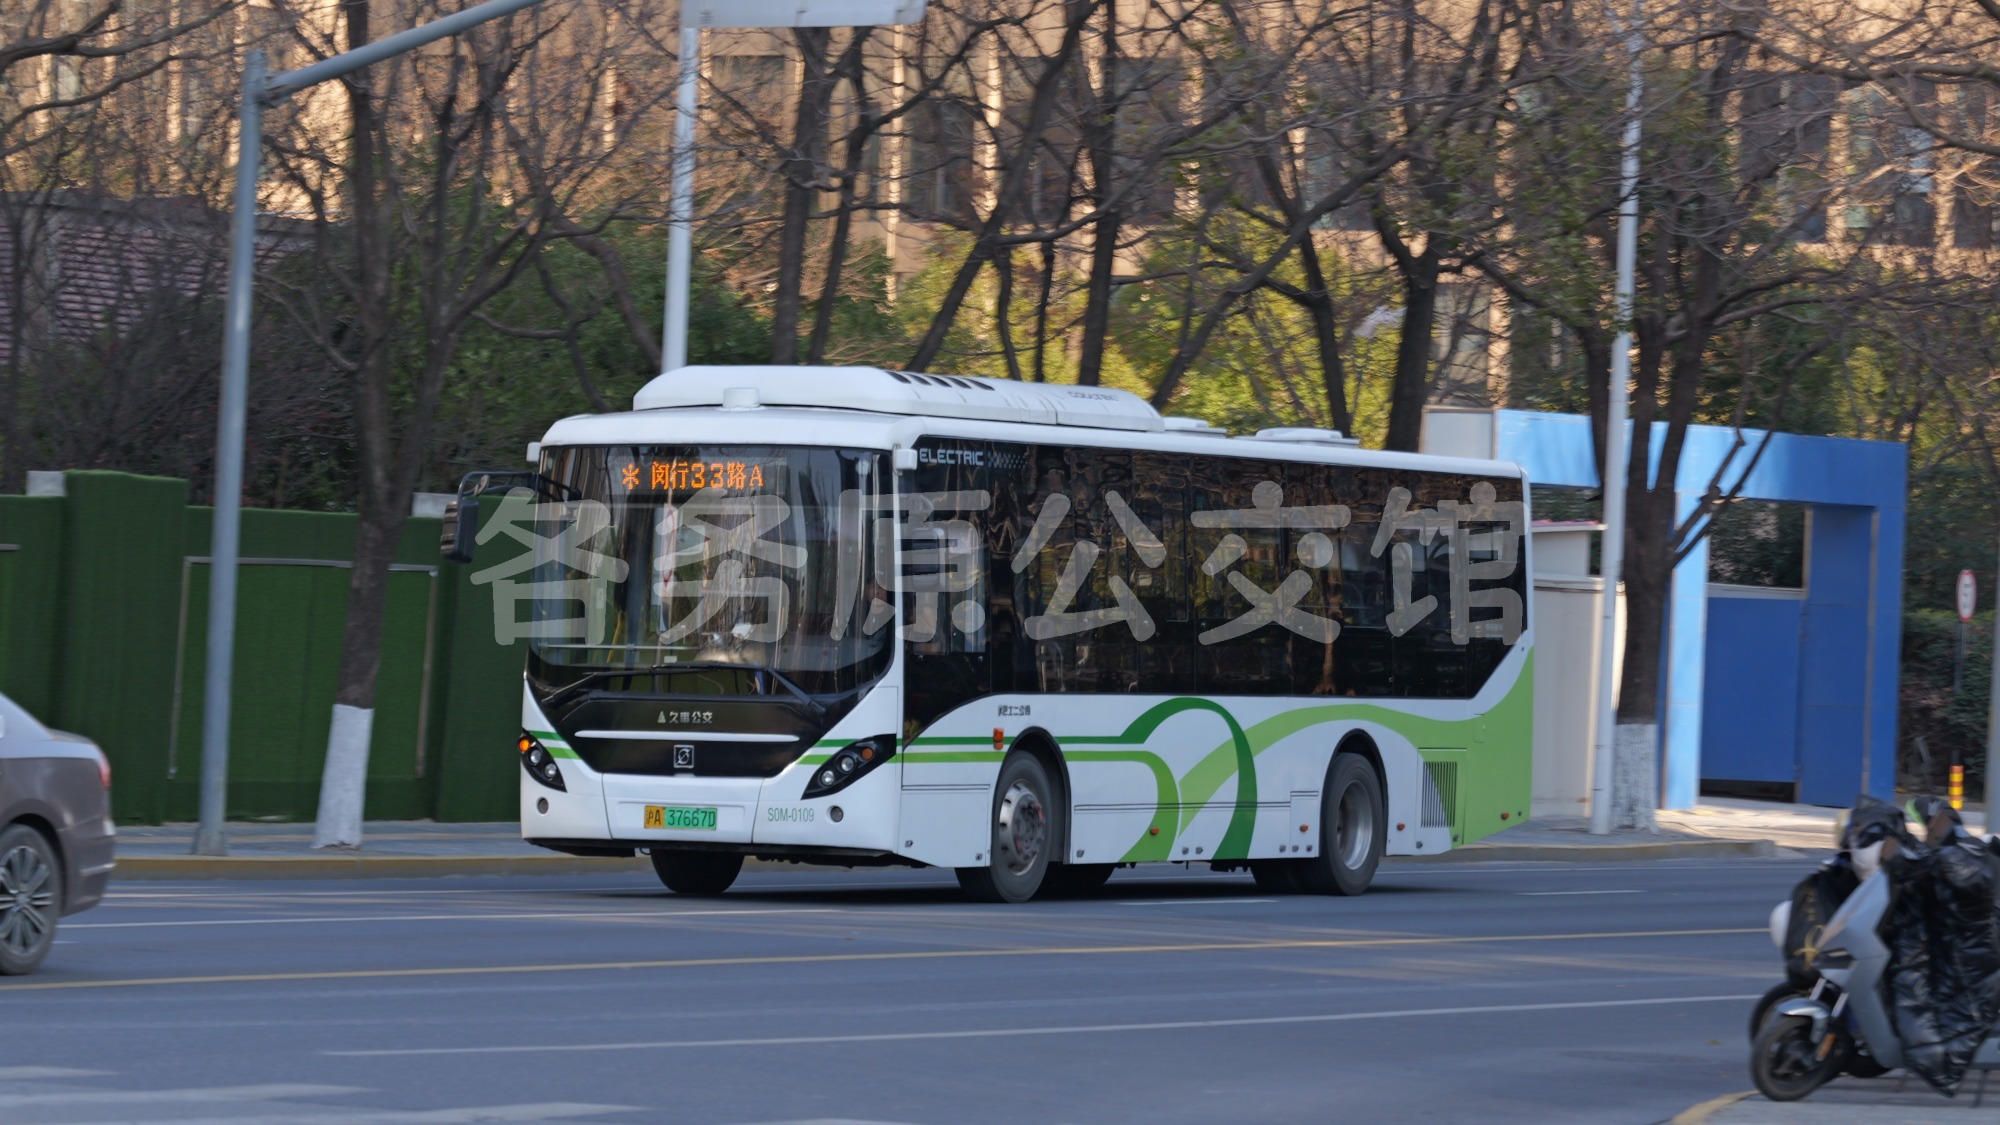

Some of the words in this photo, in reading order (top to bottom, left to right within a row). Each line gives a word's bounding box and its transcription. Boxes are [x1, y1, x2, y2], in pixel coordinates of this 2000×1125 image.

[919, 447, 984, 466] ELECTRIC
[651, 460, 764, 490] 闵行33路A
[668, 711, 713, 724] 久事公交
